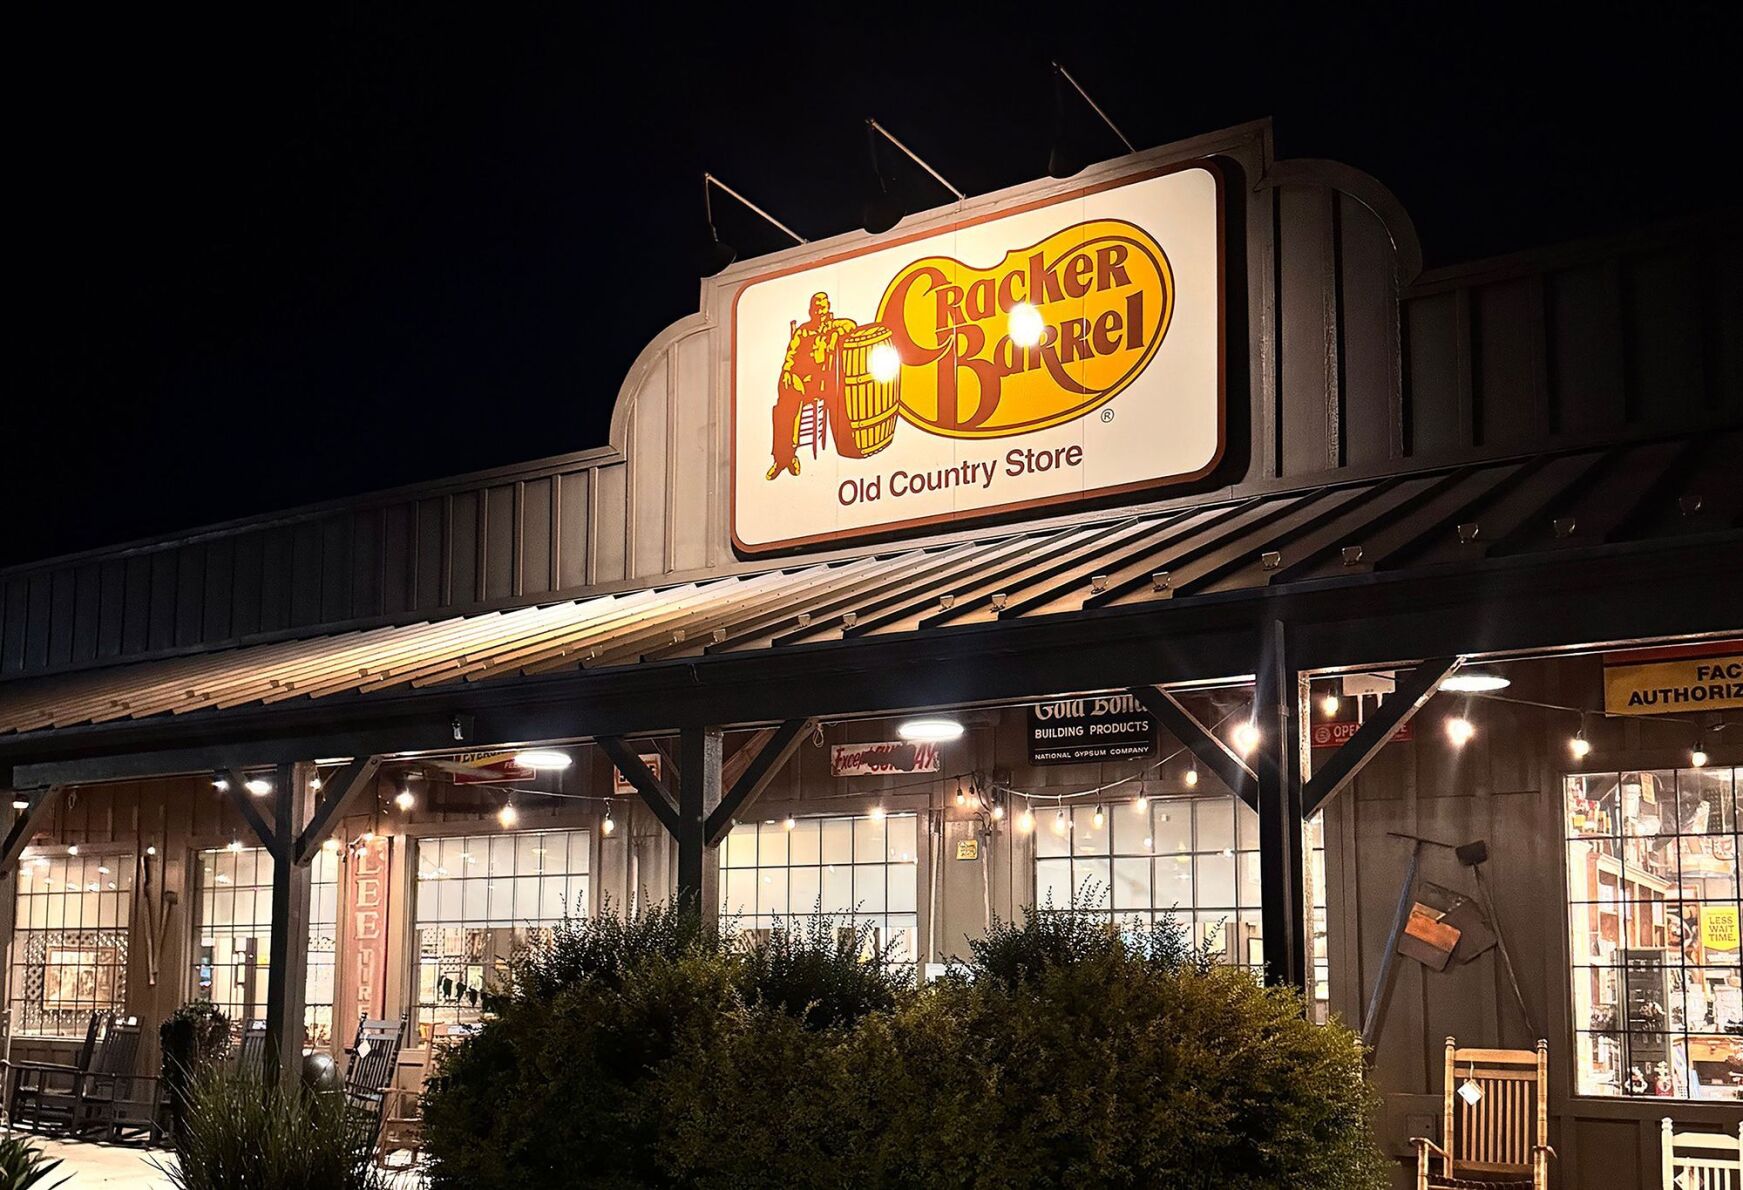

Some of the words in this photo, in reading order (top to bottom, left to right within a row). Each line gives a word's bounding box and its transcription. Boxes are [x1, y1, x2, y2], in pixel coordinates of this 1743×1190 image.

[838, 475, 880, 506] Old
[889, 460, 997, 496] Country
[1005, 445, 1083, 477] Store
[1696, 663, 1743, 681] FAC
[1035, 726, 1084, 739] BUILDING
[1090, 721, 1149, 735] PRODUCTS
[1035, 752, 1071, 760] NATIONAL
[1075, 749, 1106, 758] GYPSUM
[1110, 746, 1149, 755] COMPANY
[1709, 916, 1733, 925] LESS
[1709, 925, 1735, 933] WAIT
